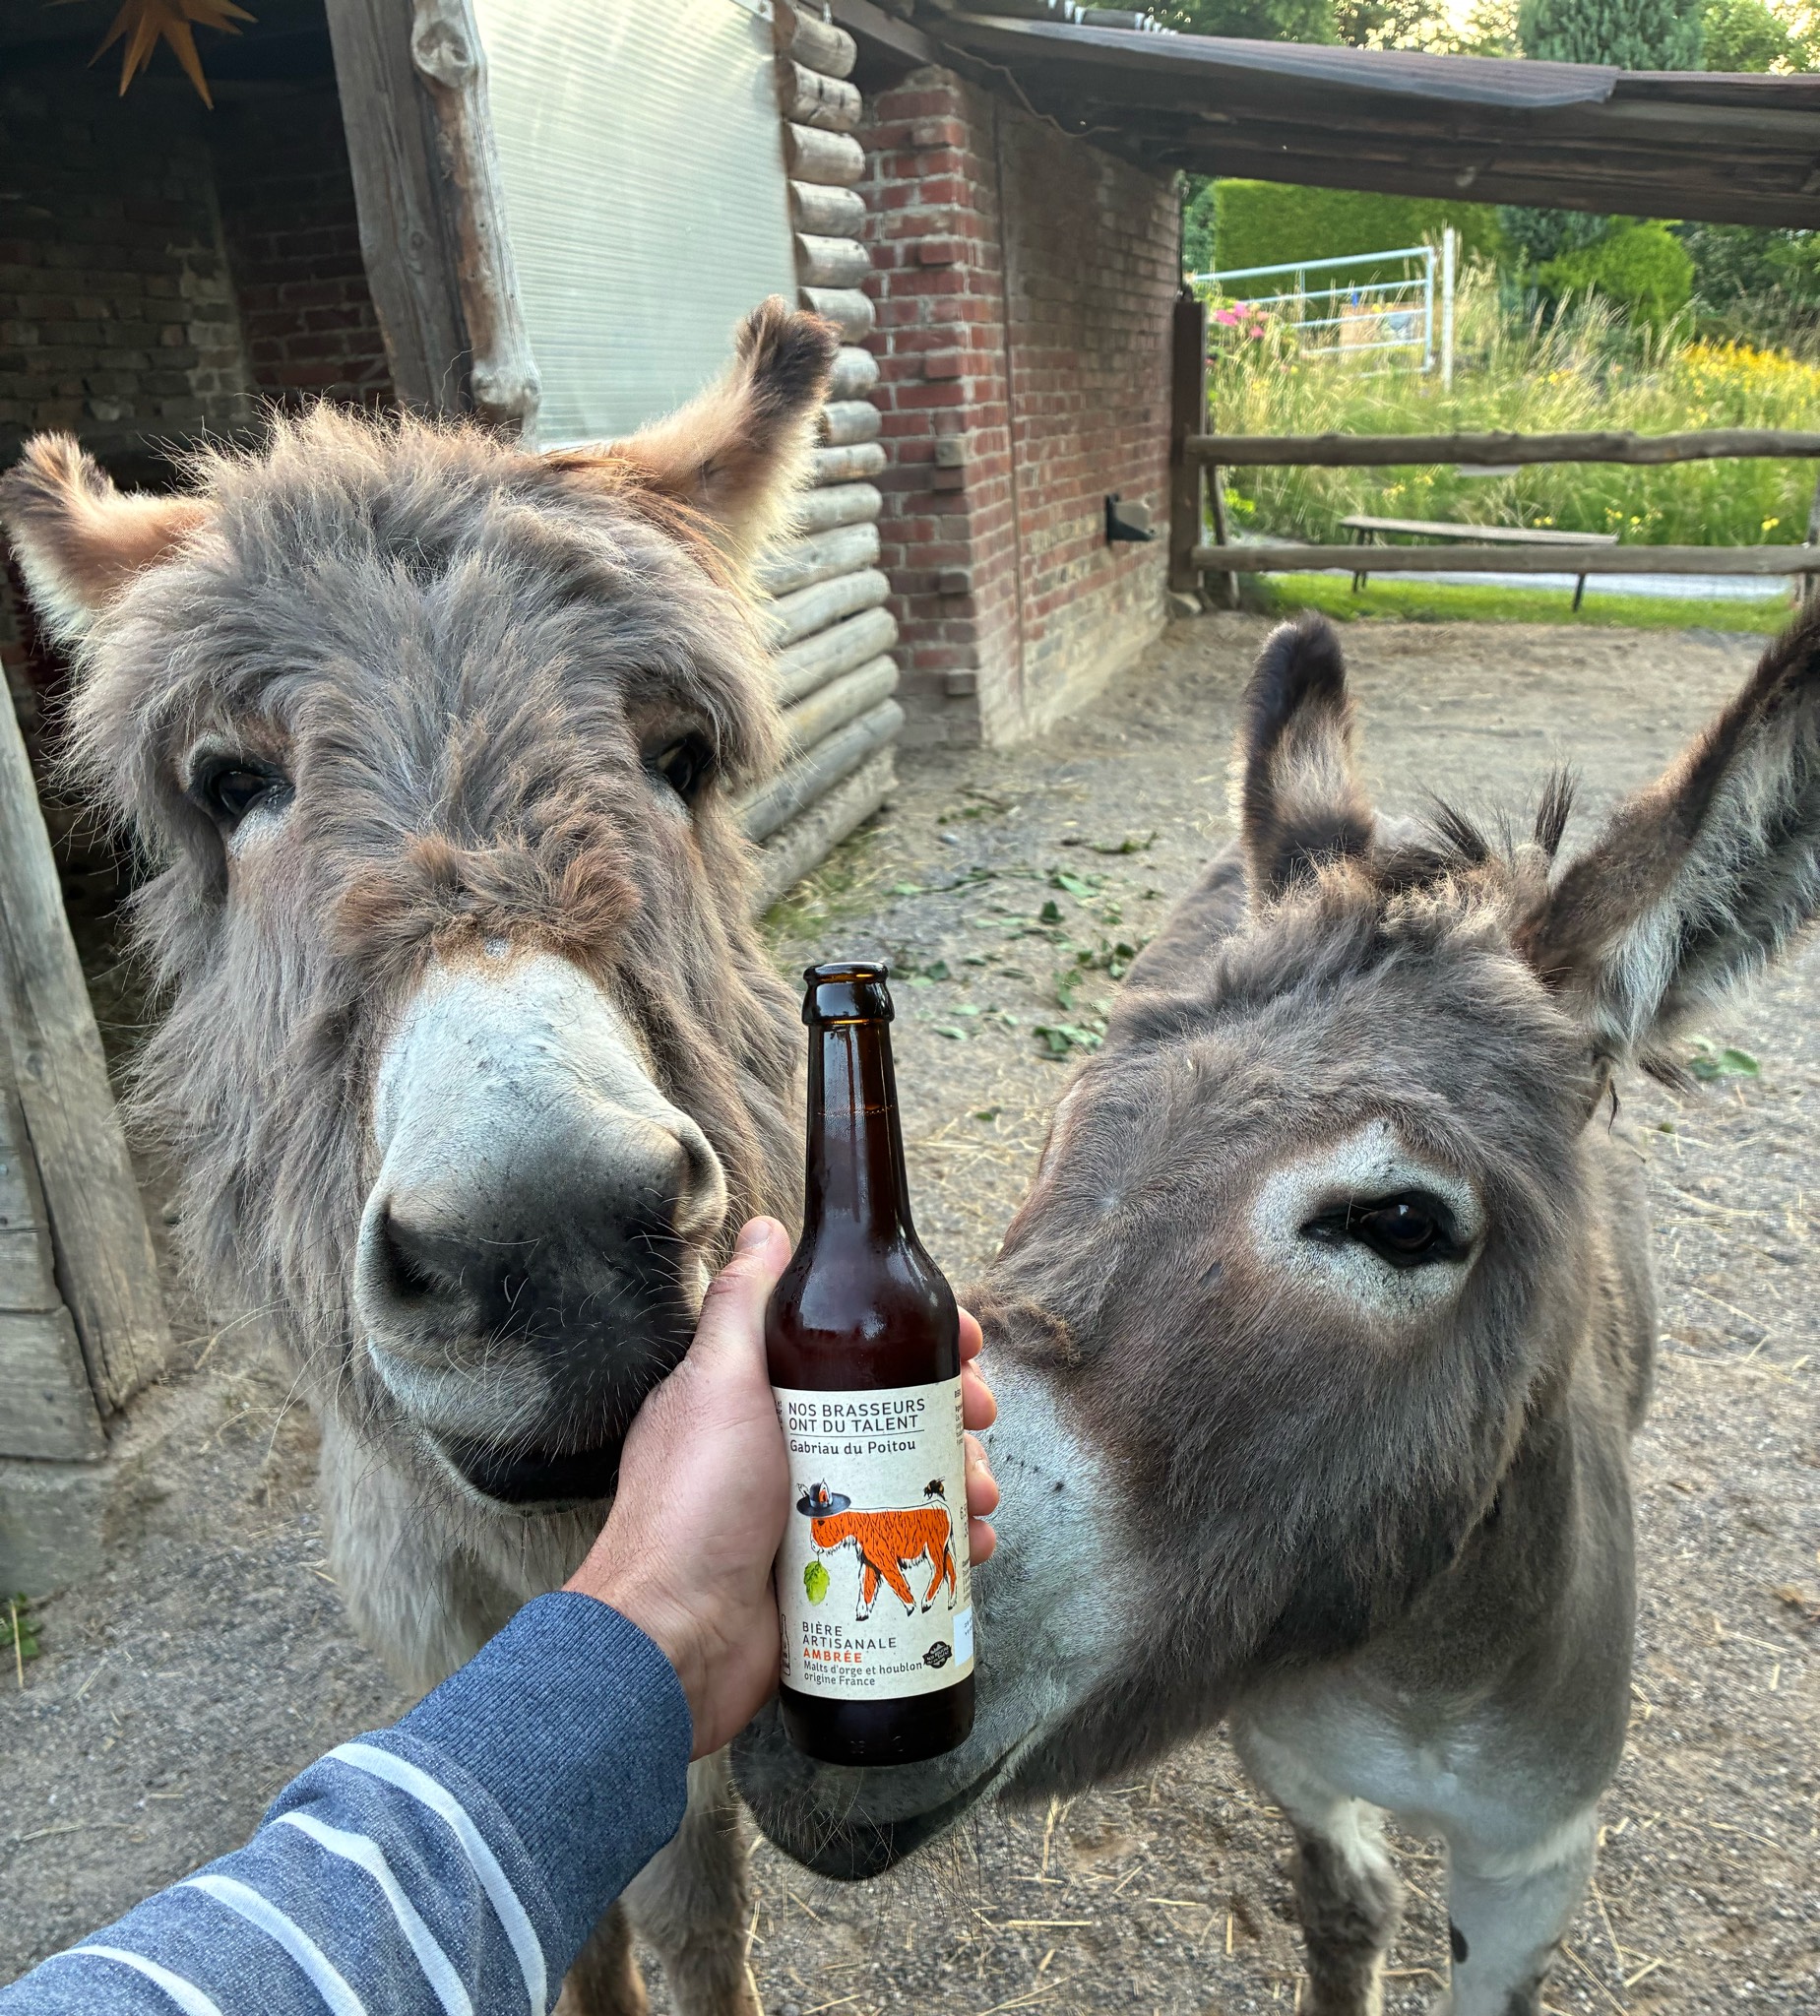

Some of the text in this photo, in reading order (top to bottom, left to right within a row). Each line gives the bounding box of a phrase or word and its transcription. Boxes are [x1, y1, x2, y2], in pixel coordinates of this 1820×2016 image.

[788, 1402, 817, 1417] NOS
[822, 1399, 925, 1418] BRASSEURS
[789, 1415, 918, 1433] ONT DU TALENT
[789, 1439, 916, 1455] Gabriau du Poitou
[802, 1620, 843, 1637] BIÈRE
[802, 1634, 897, 1650] ARTISANALE
[803, 1647, 862, 1664] AMBRÉE
[803, 1660, 923, 1678] Malts d'orge et houblon
[804, 1672, 876, 1686] origine France
